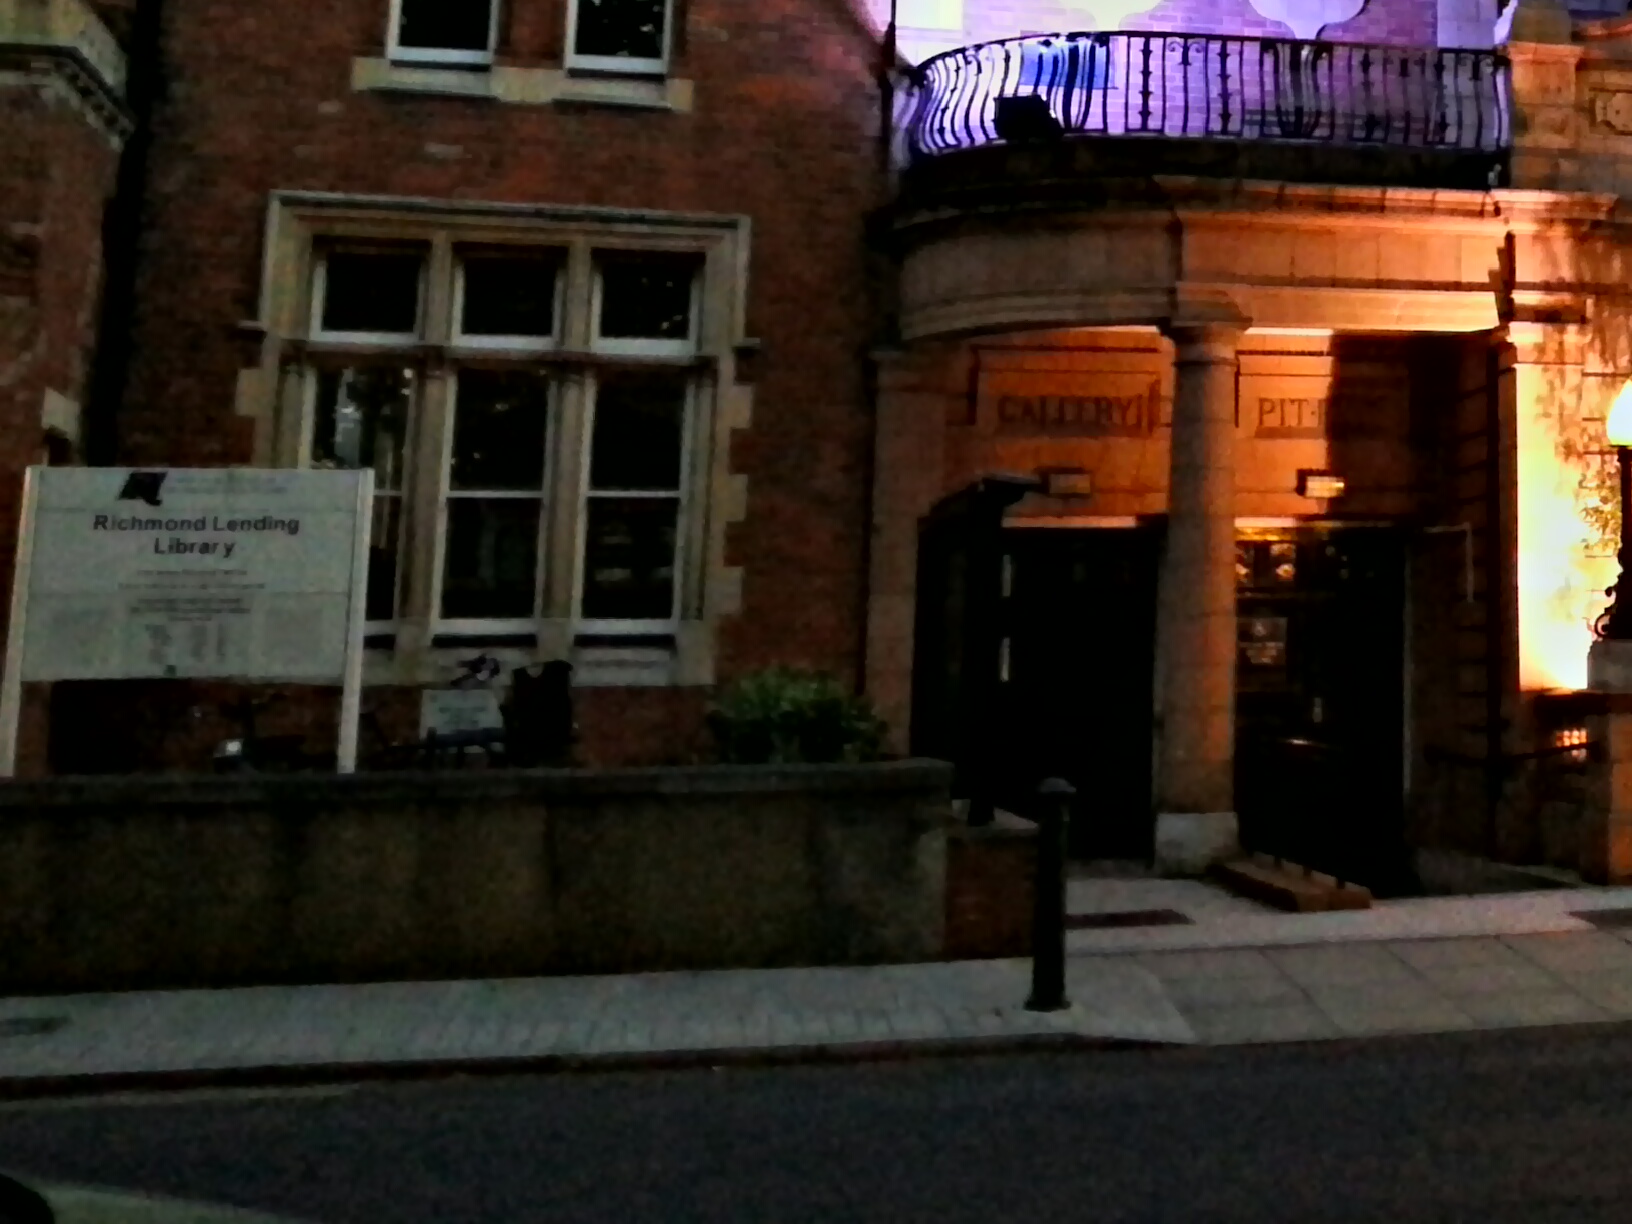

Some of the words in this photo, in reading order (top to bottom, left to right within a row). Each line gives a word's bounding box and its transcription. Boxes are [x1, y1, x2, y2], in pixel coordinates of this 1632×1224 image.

[92, 514, 207, 532] Richmond
[212, 514, 300, 535] Lending
[153, 536, 236, 558] Library
